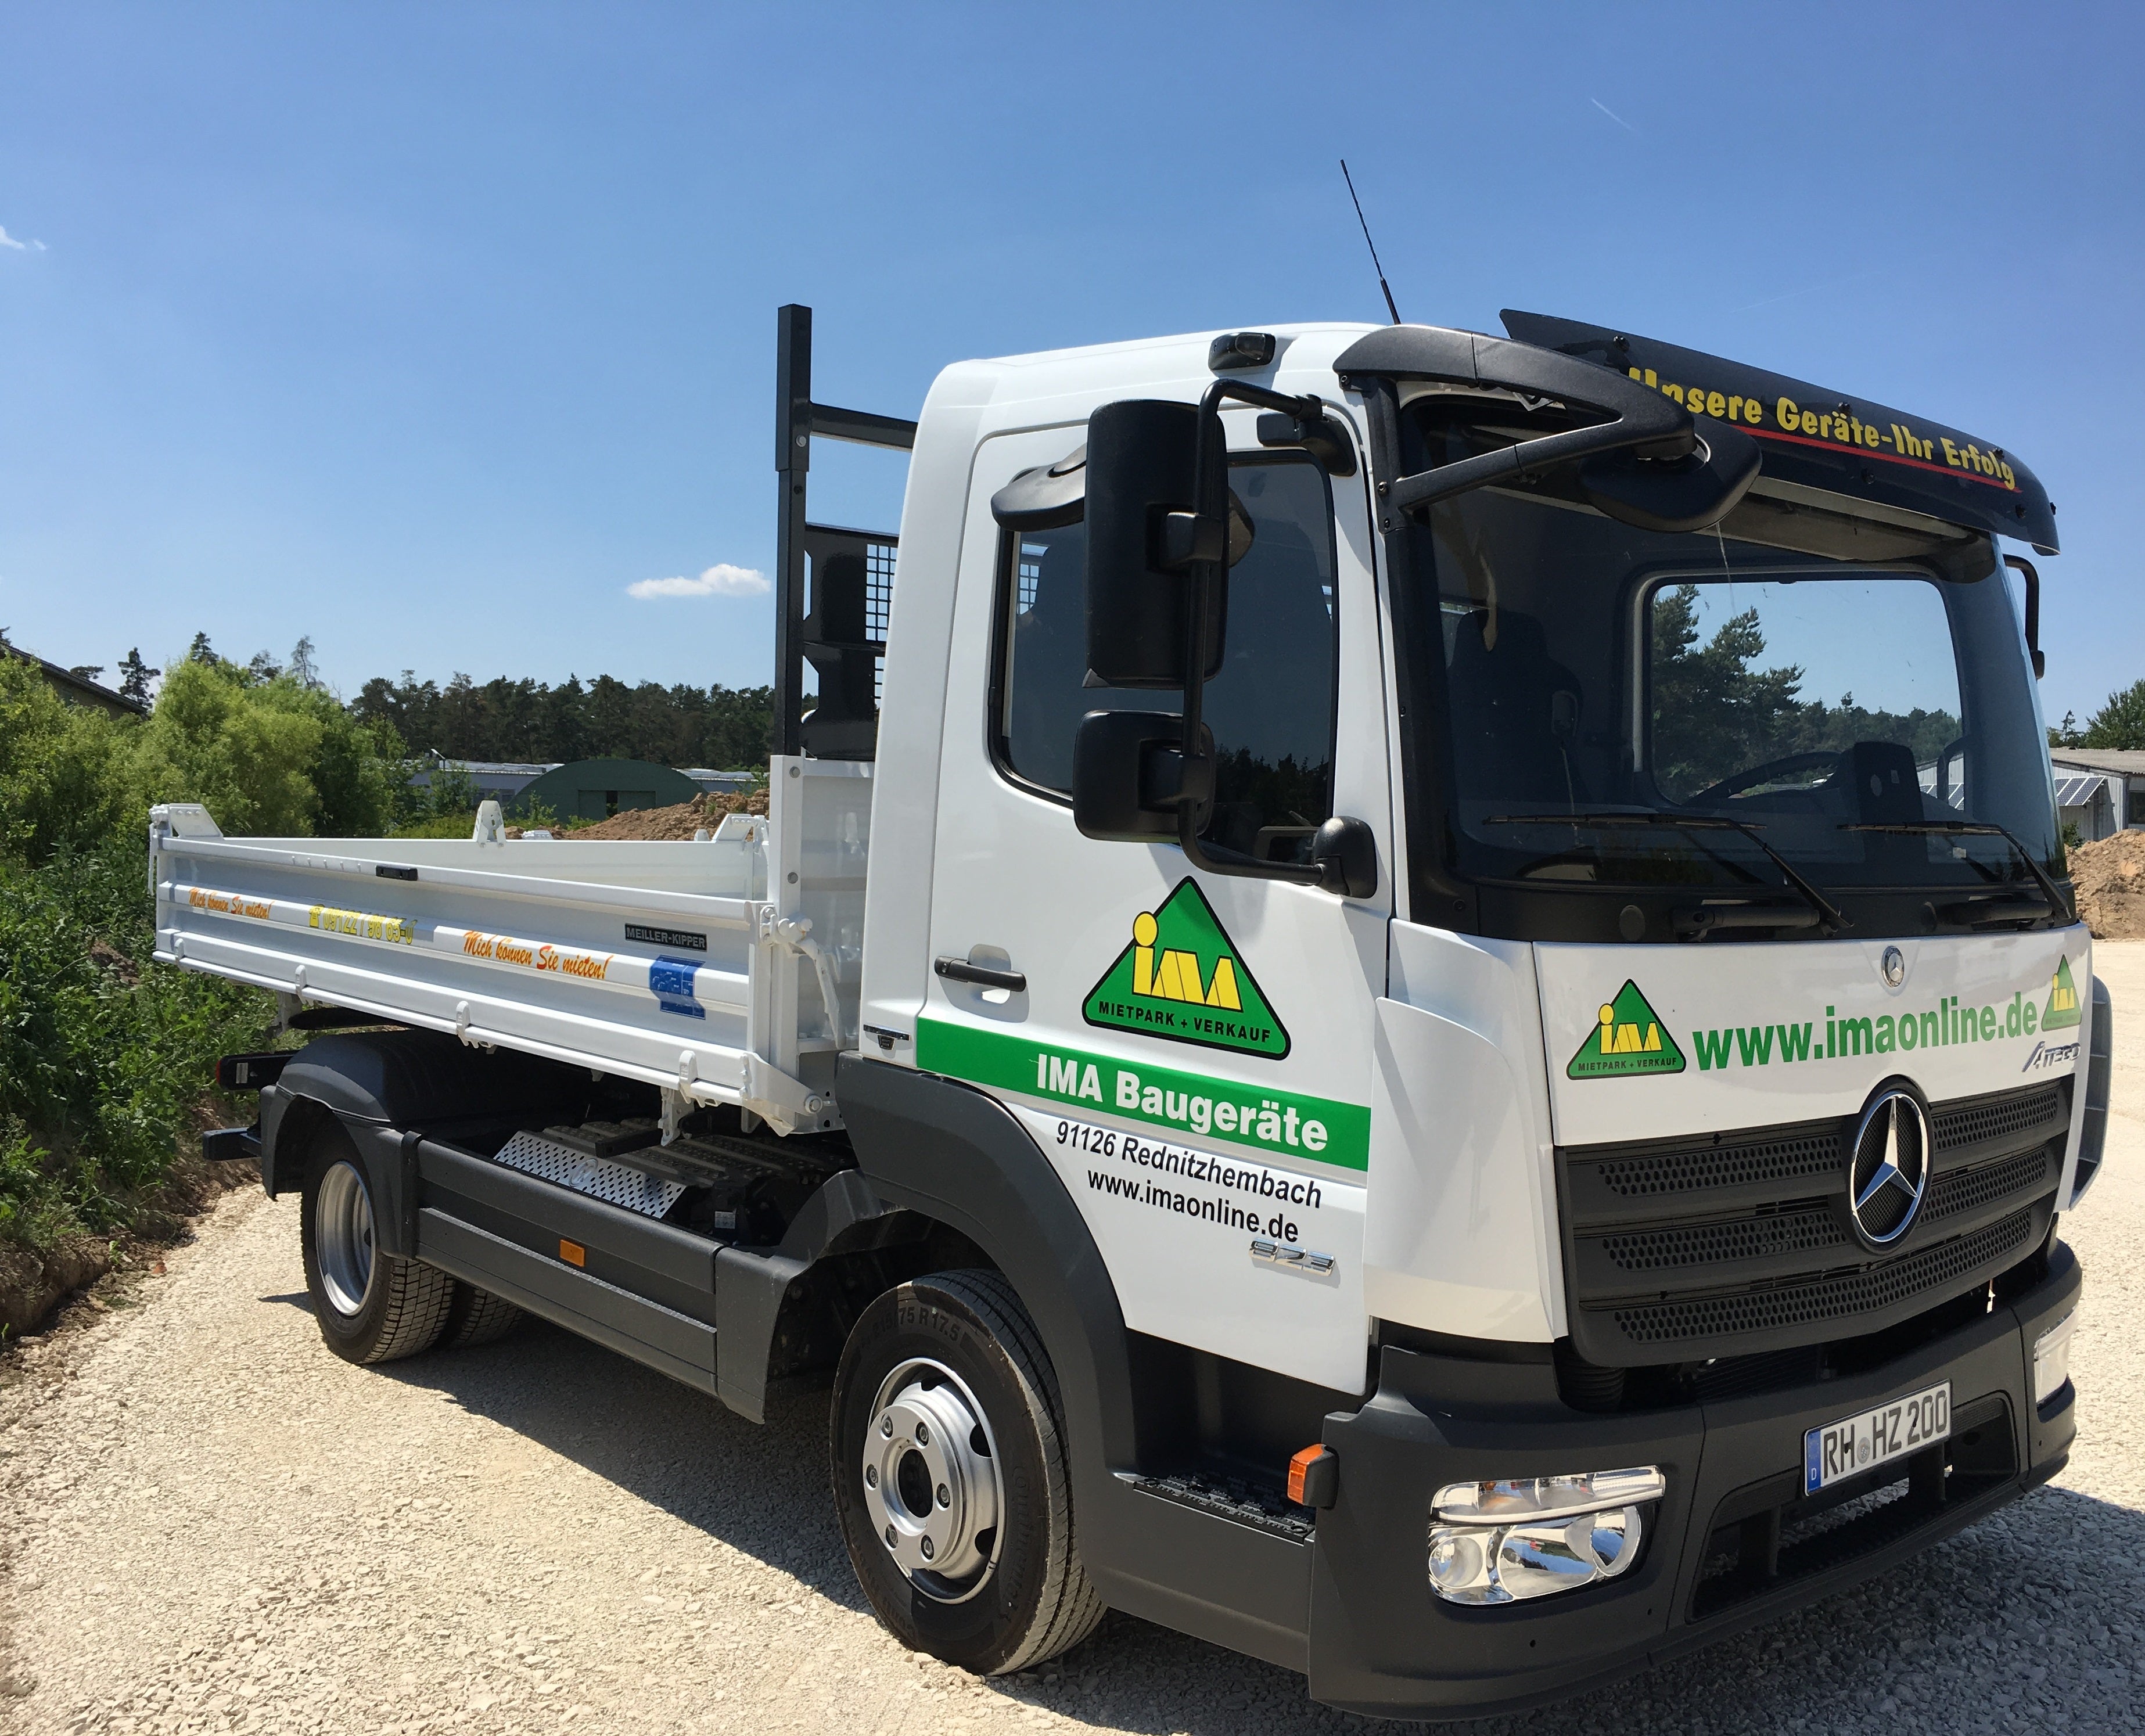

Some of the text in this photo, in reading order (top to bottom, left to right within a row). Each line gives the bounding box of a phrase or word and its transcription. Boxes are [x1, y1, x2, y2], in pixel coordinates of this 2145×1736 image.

[1777, 397, 1934, 460] Geräte-Ihr
[1940, 437, 2015, 490] Erfolg
[464, 930, 498, 958] Mich
[537, 945, 559, 971] Sie
[562, 954, 614, 980] mieten!
[627, 927, 705, 948] MEILLER-KIPPER
[1099, 1001, 1175, 1027] MIETPARK
[1194, 1017, 1271, 1043] VERKAUF
[1692, 991, 2038, 1070] www.imaonline.de
[1578, 1059, 1627, 1072] MIETPARK
[1637, 1057, 1677, 1068] VERKAUF
[1037, 1054, 1328, 1151] IMA Baugeräte
[1056, 1121, 1322, 1209] 91126 Rednitzhembach
[1087, 1170, 1299, 1243] www.imaonline.de
[1823, 1390, 1948, 1479] RH HZ 200
[1811, 1467, 1817, 1481] D
